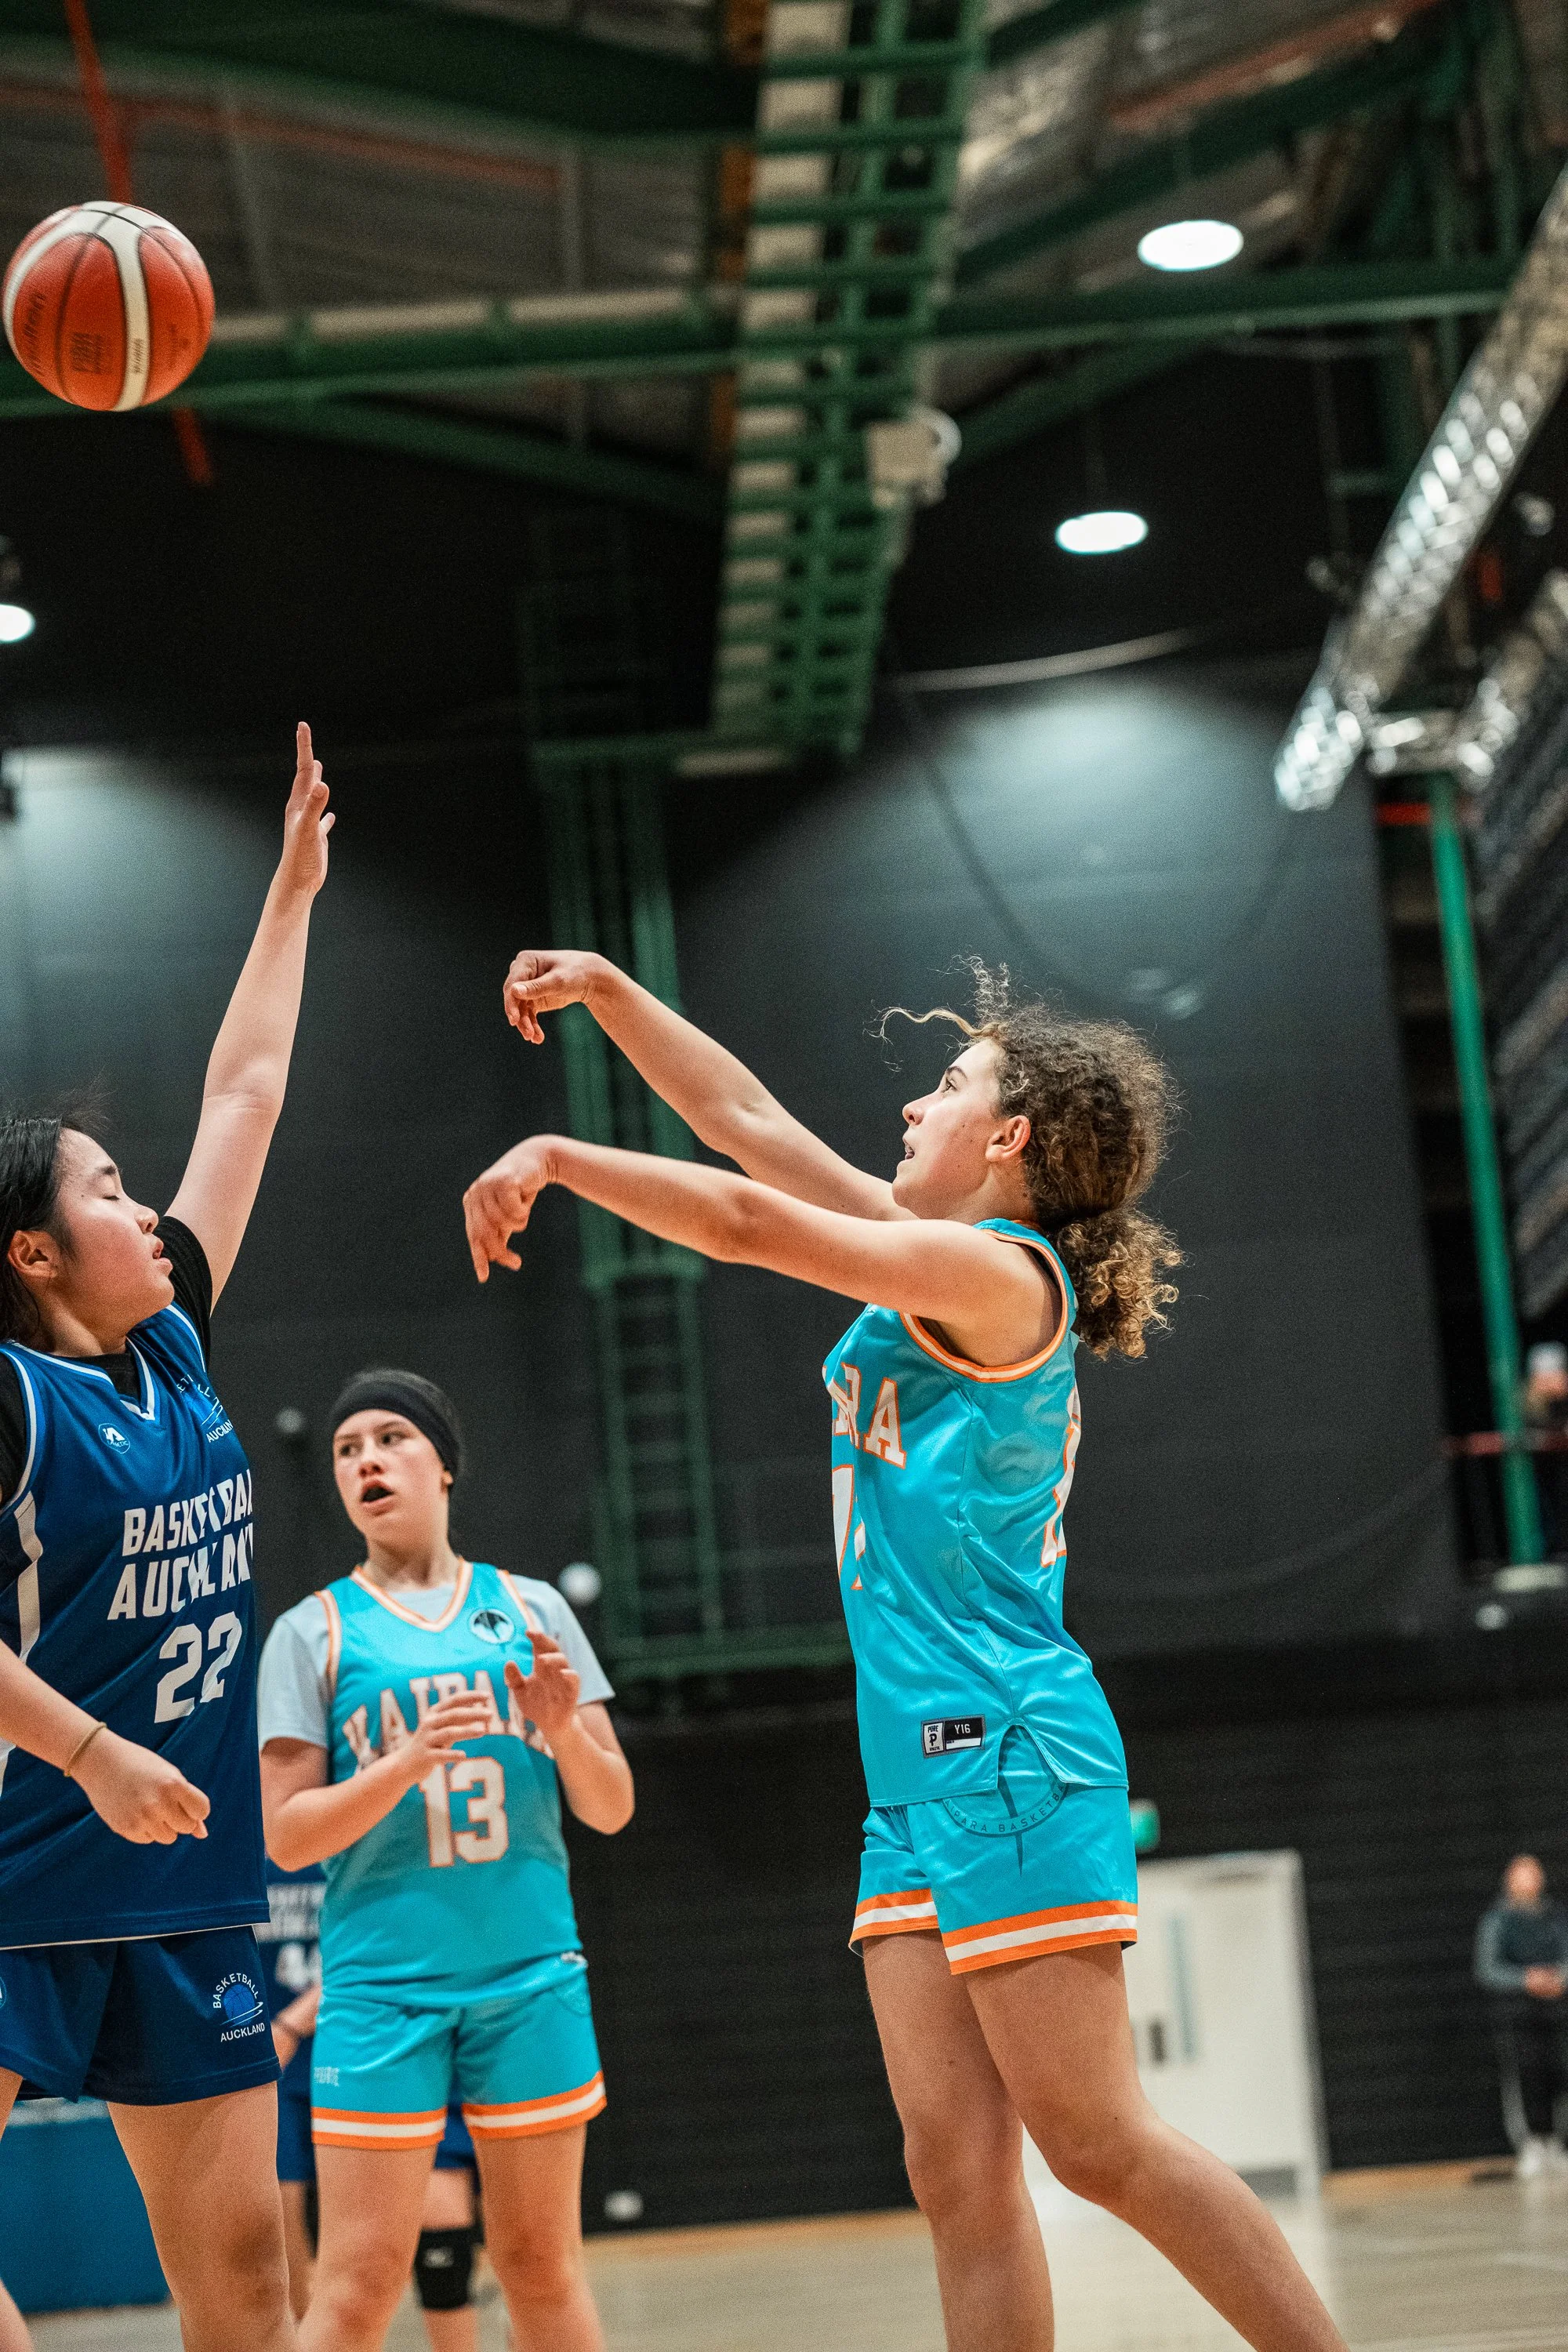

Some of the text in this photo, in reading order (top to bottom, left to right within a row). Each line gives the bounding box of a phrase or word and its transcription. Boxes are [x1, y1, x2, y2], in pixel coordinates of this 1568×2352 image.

[206, 1419, 234, 1443] AUCKLAN
[154, 1610, 242, 1723] 22
[954, 1723, 971, 1734] Y16
[418, 1756, 510, 1867] 13
[944, 1784, 1065, 1832] AIPARA BASKETBA
[213, 1973, 259, 2008] BASKETBALL
[220, 2022, 265, 2042] AUCKLAND
